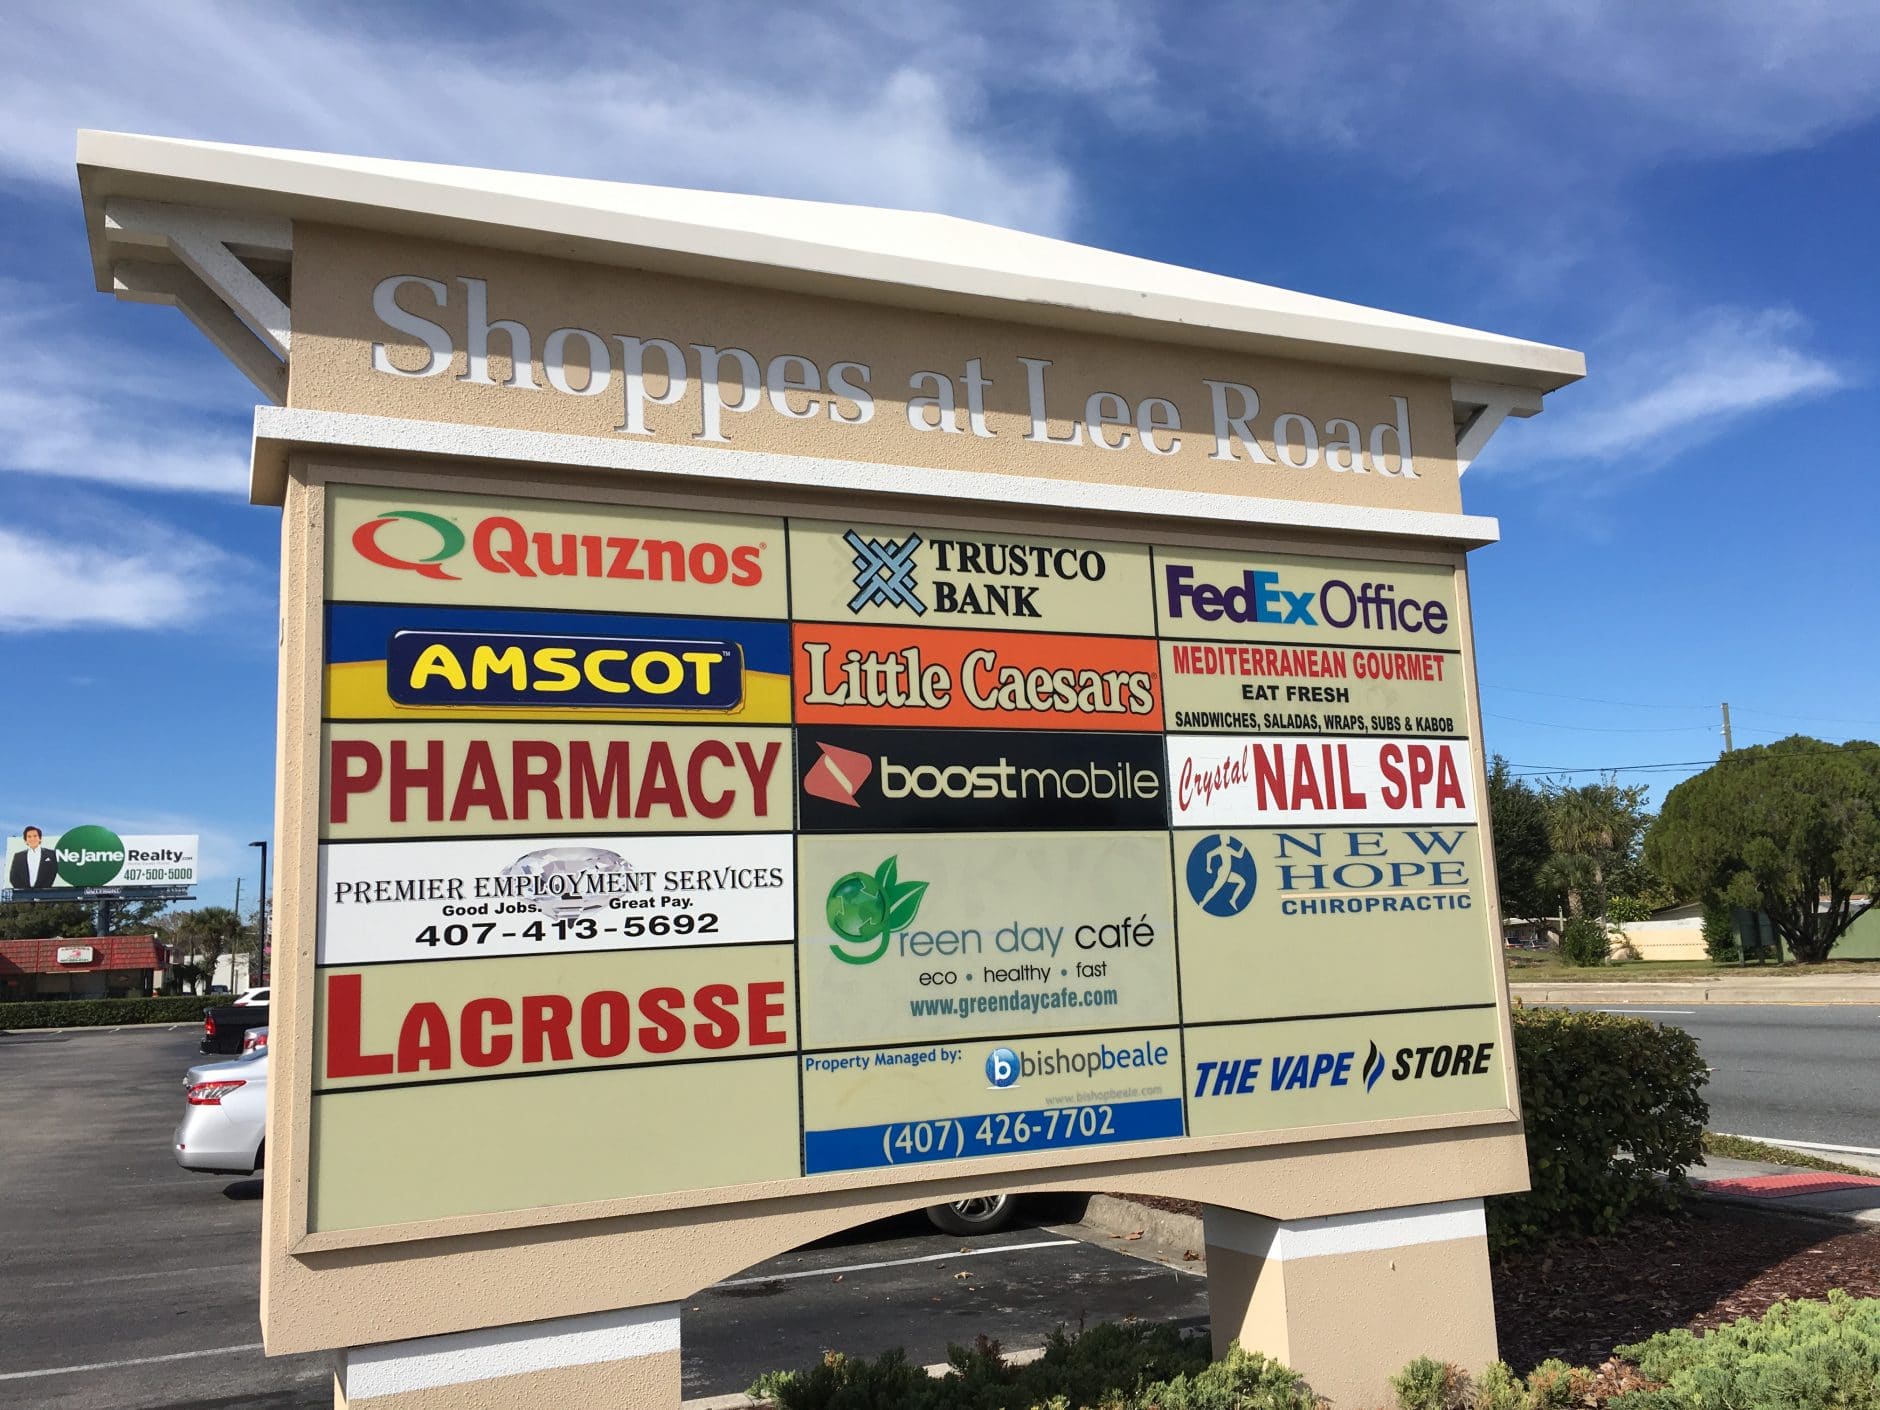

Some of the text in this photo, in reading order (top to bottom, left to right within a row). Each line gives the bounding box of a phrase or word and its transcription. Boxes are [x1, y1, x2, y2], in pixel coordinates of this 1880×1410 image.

[372, 274, 1422, 479] Shoppes at Lee Road
[472, 516, 763, 587] Quiznos
[929, 539, 1106, 581] TRUSTCO
[932, 581, 1042, 618] BANK
[1166, 564, 1448, 634] FedEx Office
[410, 644, 723, 695] AMSCOT
[802, 642, 1155, 715] Little Caesars
[1173, 645, 1444, 682] MEDITERRANEAN GOURMET
[1242, 684, 1349, 703] EAT FRESH
[1175, 711, 1454, 733] SANDWICHES, SALADAS, WRAPS, SUBS & KABOB
[330, 739, 782, 824] PHARMACY
[1178, 743, 1466, 812] Crystal NAIL SPA
[56, 848, 124, 866] NeJame
[1273, 831, 1468, 858] NEW
[334, 865, 784, 904] PREMIER EMPLOYMENT SERVICES
[1274, 861, 1470, 891] HOPE
[442, 896, 694, 916] Good Jobs. Great Pay.
[1281, 895, 1472, 915] CHIROPRACTIC
[415, 912, 719, 947] 407-413-5692
[995, 921, 1063, 957] day
[1074, 914, 1155, 950] café
[919, 961, 1107, 986] eco healthy fast
[910, 987, 1118, 1018] www.greendaycafe.com
[805, 1048, 962, 1072] Property Managed by:
[1020, 1041, 1168, 1078] bishopbeale
[1194, 1043, 1494, 1098] THE VAPE STORE
[1045, 1085, 1163, 1105] www.bishopbeale.com
[882, 1105, 1115, 1164] (407) 426-7702
